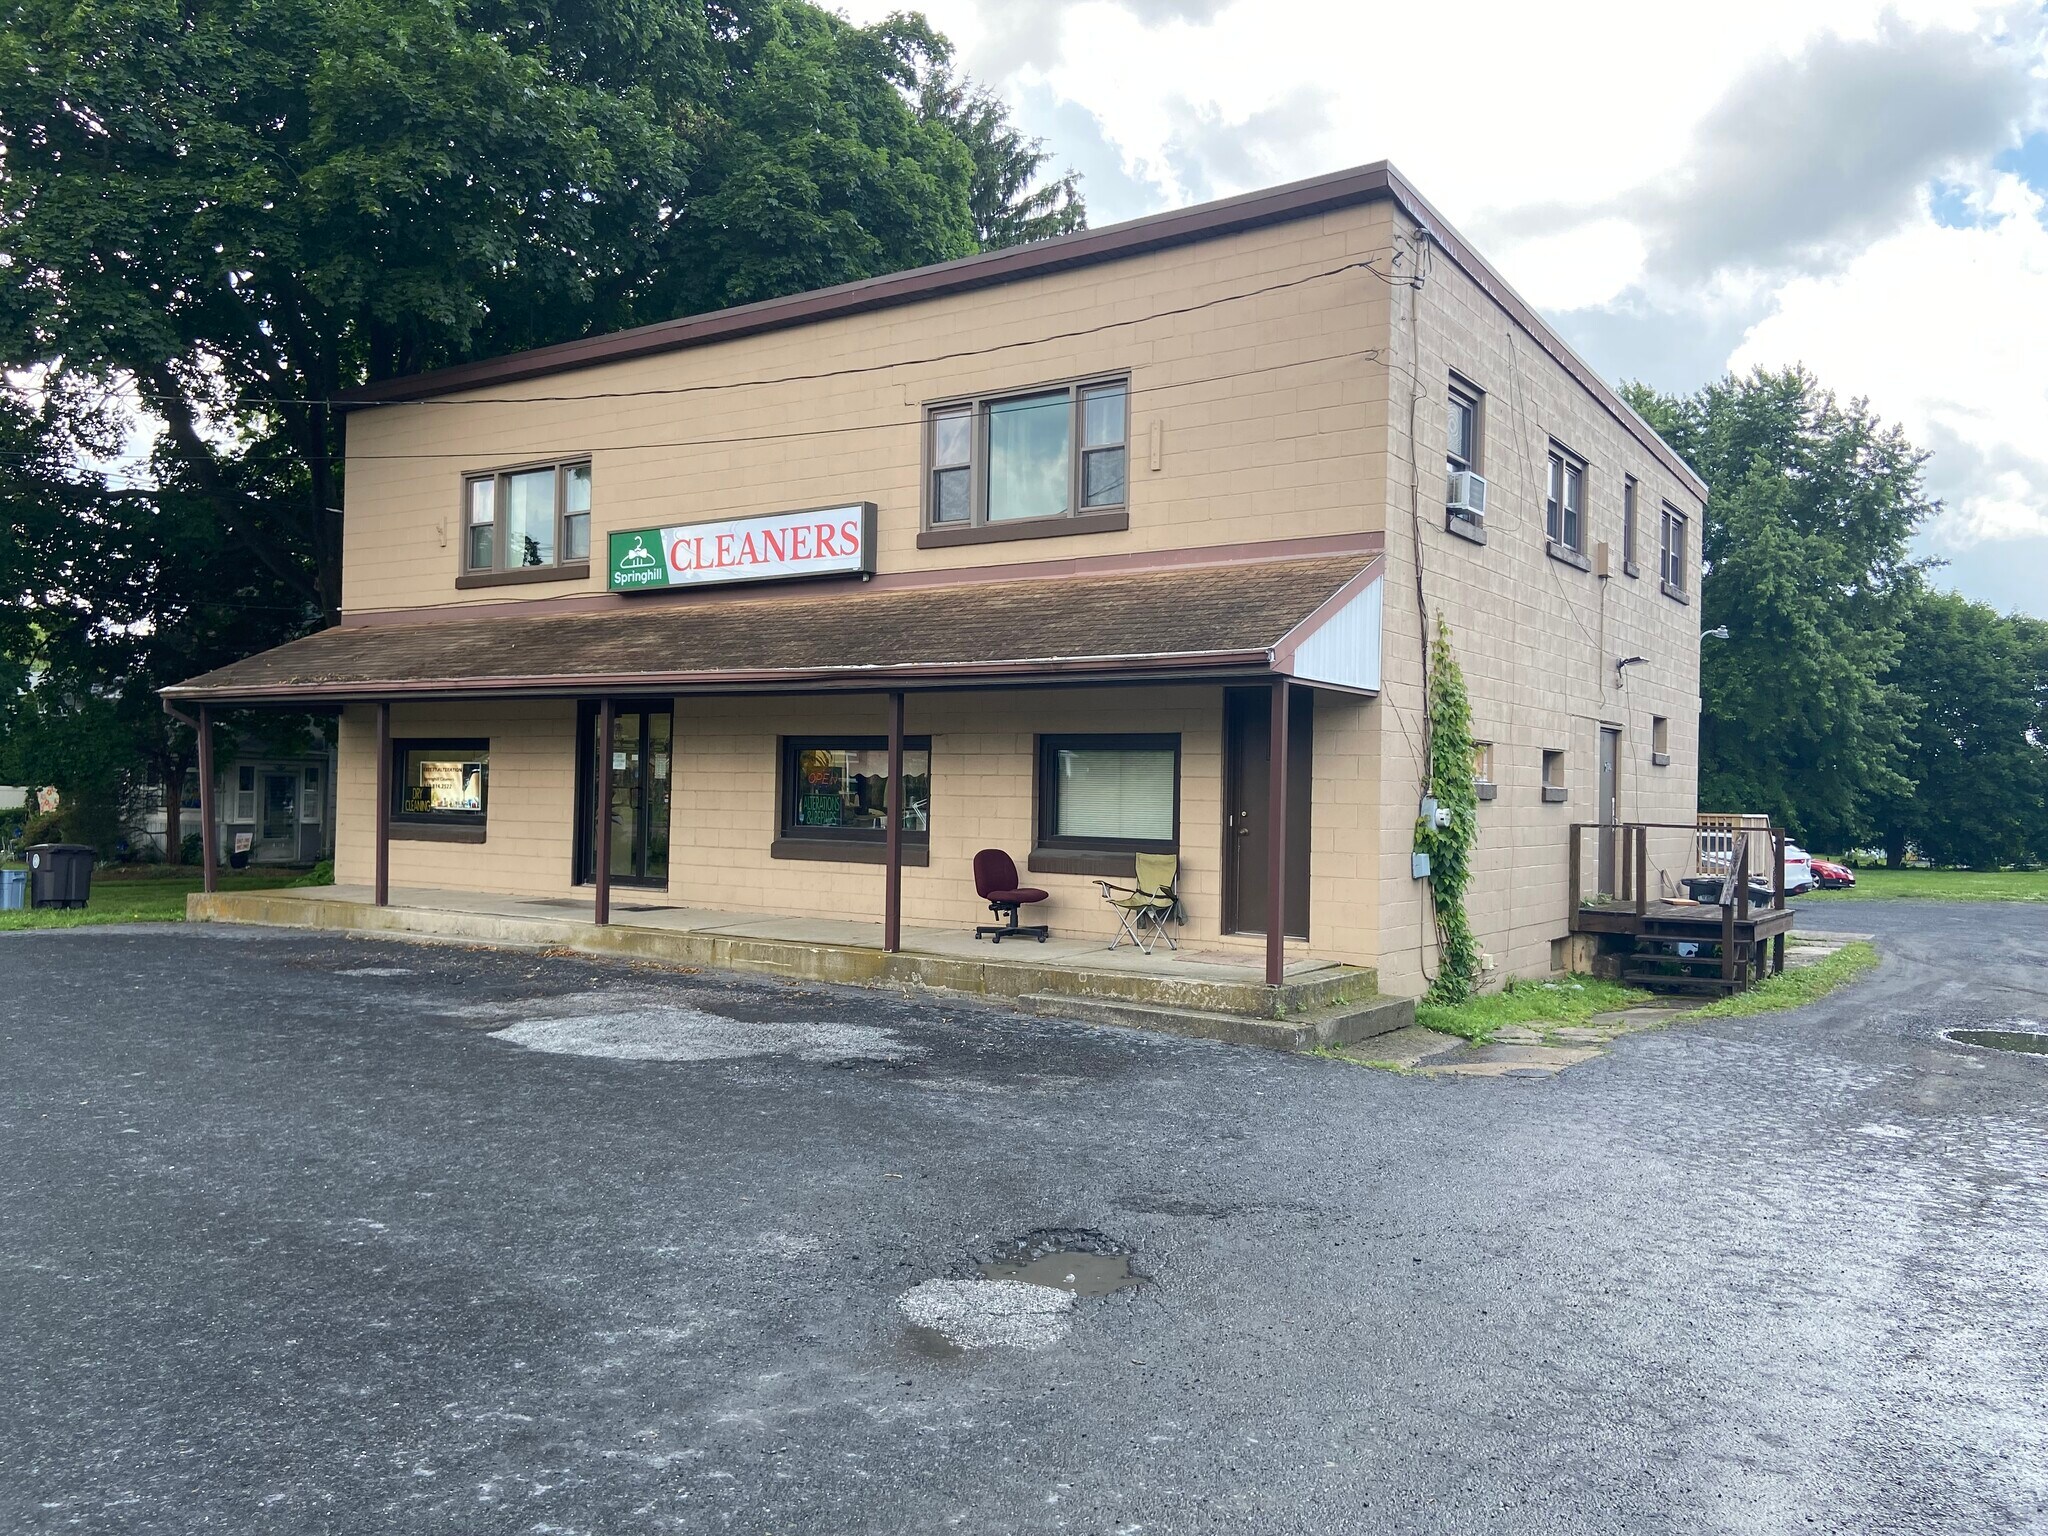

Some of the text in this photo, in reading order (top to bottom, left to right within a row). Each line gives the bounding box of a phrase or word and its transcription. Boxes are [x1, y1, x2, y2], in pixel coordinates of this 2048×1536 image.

[670, 520, 860, 572] CLEANERS
[614, 568, 662, 585] Springhill
[808, 772, 838, 785] OPEN
[412, 787, 423, 799] DRY
[405, 799, 431, 812] CLEANING
[803, 796, 840, 811] ALTERATIONS
